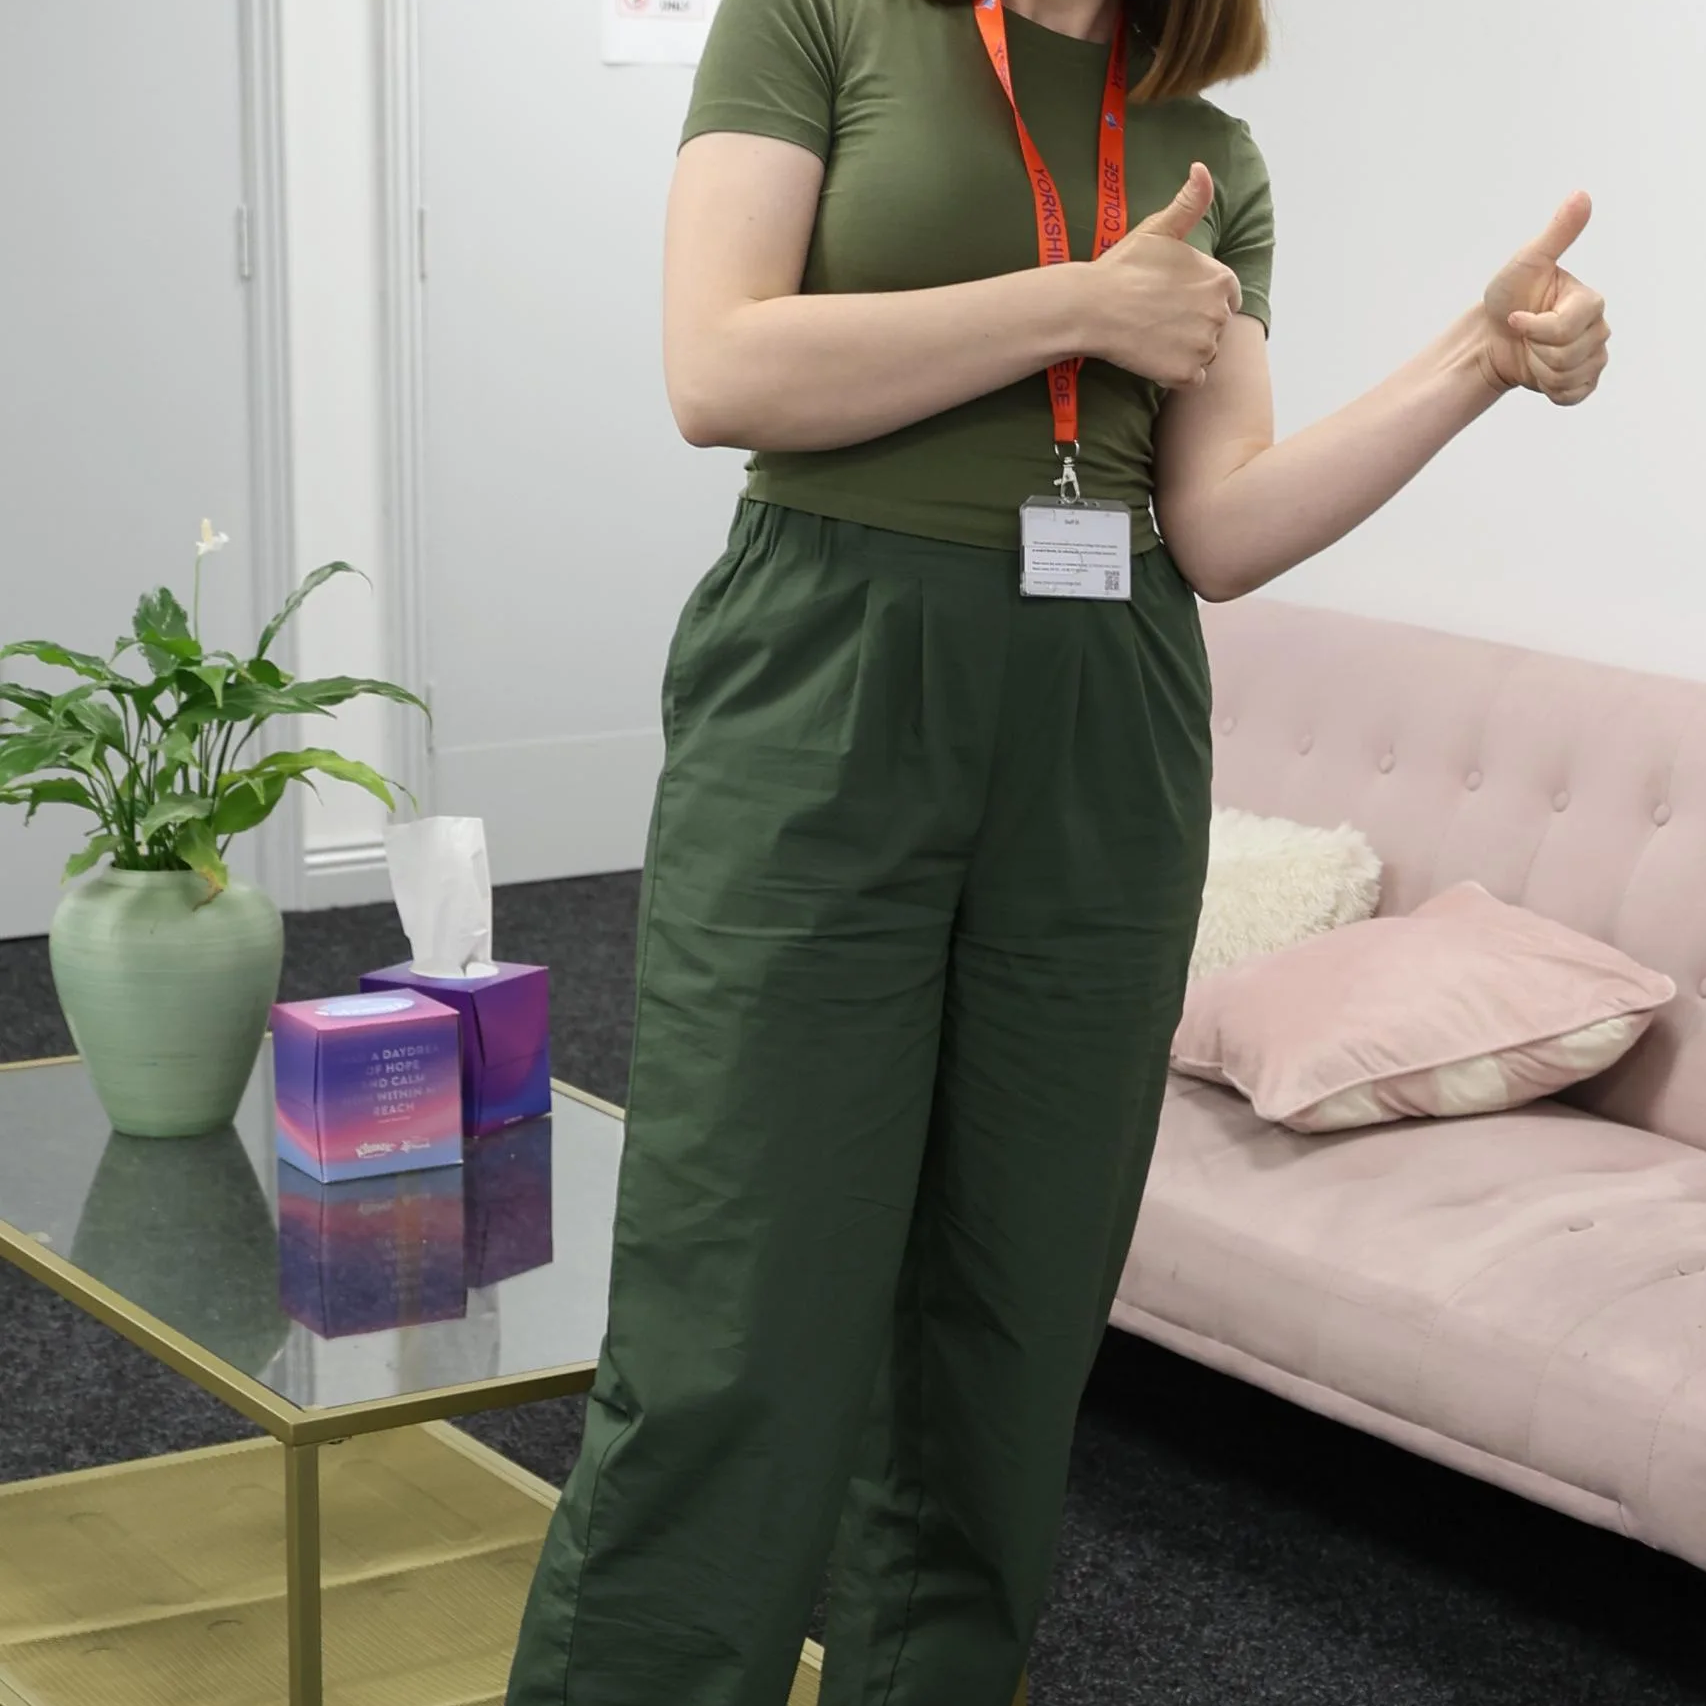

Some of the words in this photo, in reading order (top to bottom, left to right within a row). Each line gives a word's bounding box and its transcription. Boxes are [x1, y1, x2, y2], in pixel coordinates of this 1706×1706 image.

[1103, 157, 1121, 232] COLLEGE
[1033, 168, 1065, 266] YORKSHI
[382, 1044, 445, 1060] DAYDREA
[385, 1060, 421, 1074] HOPE
[377, 1086, 423, 1102] WITHIN
[373, 1101, 415, 1116] REACH
